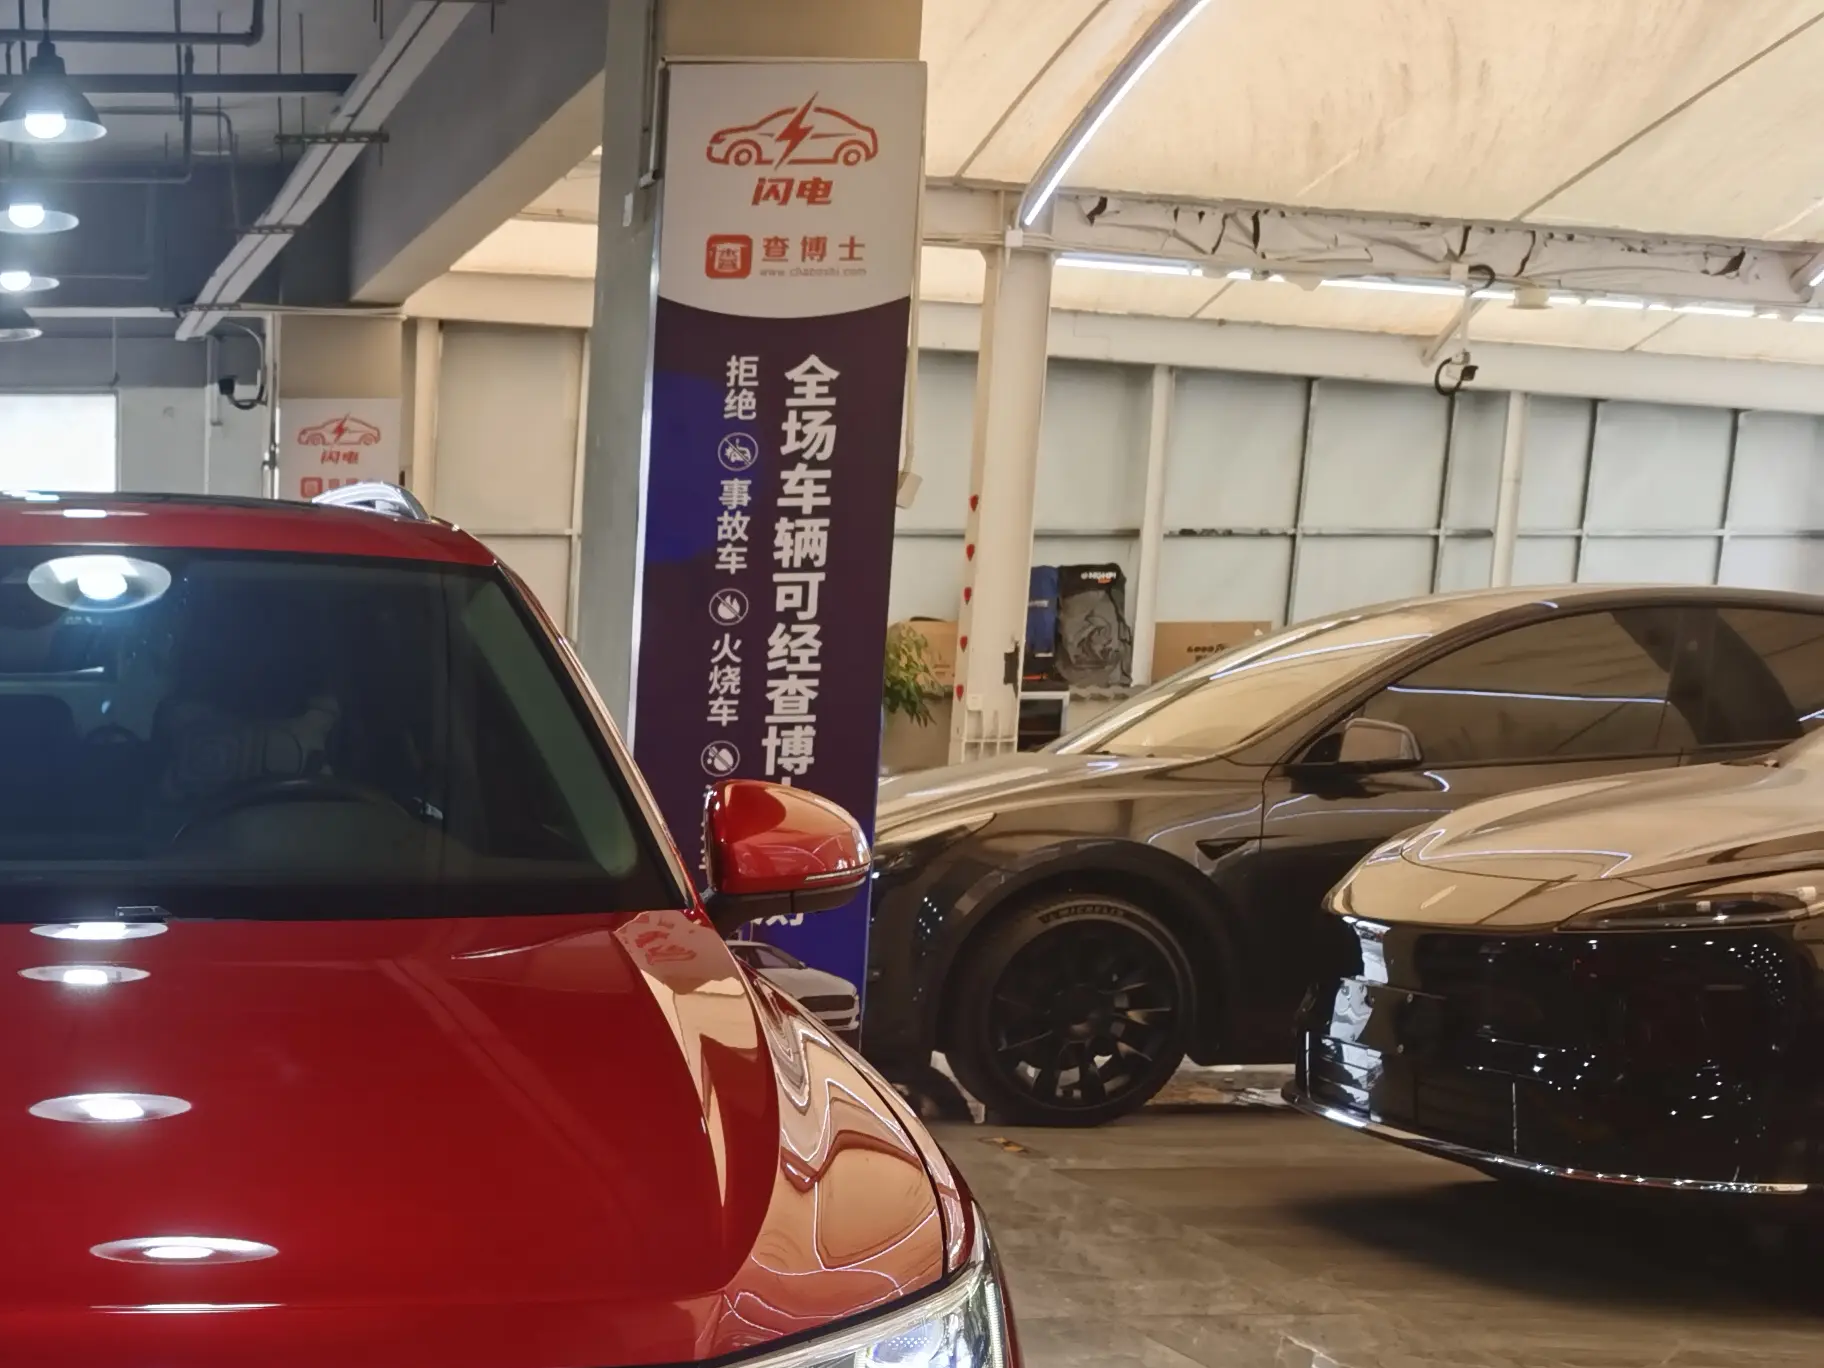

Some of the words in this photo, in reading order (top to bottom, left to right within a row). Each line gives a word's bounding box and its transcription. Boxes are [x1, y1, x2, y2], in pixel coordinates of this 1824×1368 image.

[751, 177, 834, 206] 闪电
[761, 235, 866, 263] 查博士
[723, 355, 759, 420] 拒绝
[715, 478, 752, 575] 事故车
[761, 354, 840, 787] 全场车辆可经查博
[707, 633, 742, 726] 火烧车
